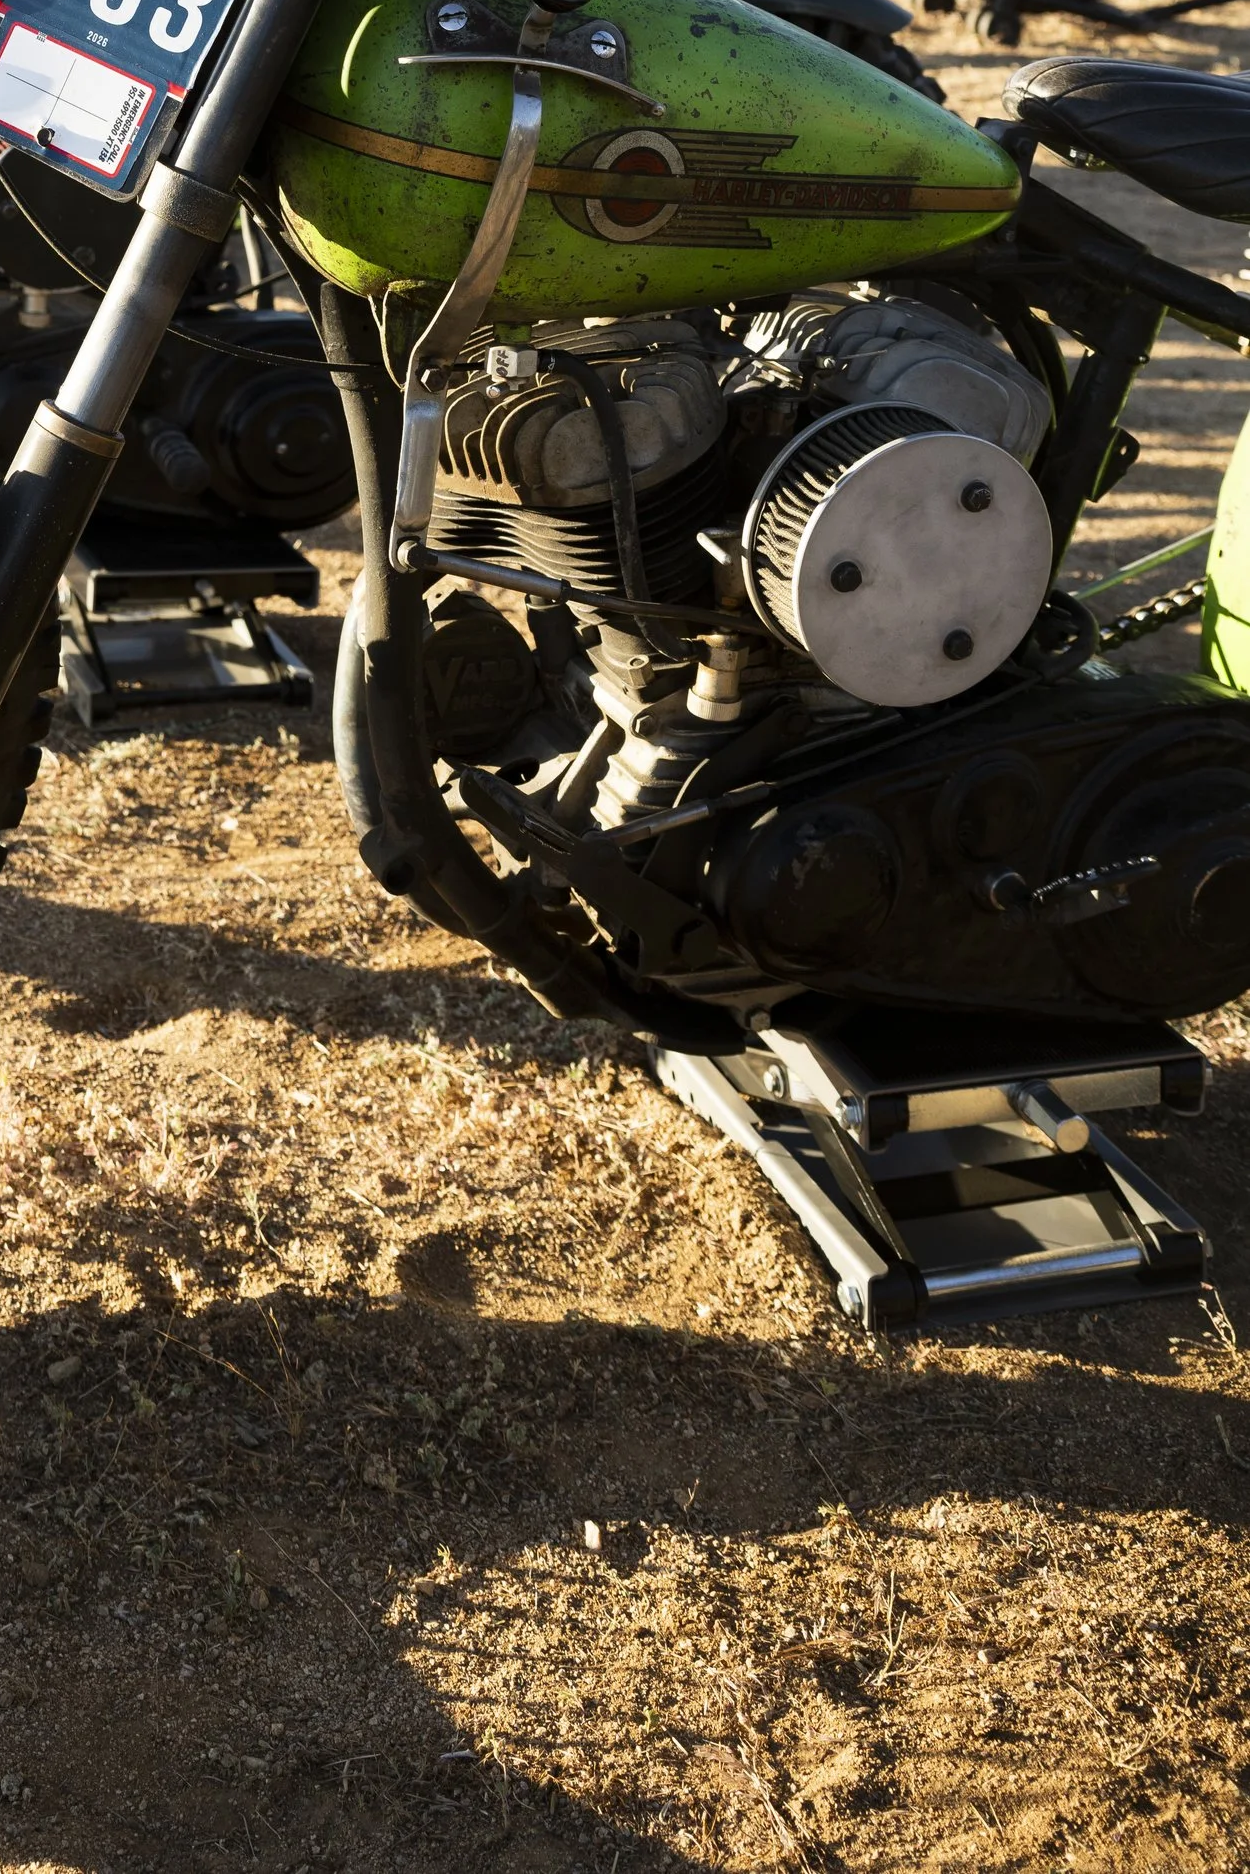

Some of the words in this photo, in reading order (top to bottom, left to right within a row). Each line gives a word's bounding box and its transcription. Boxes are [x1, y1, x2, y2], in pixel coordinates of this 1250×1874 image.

[86, 30, 109, 48] 2026
[137, 89, 146, 100] IN
[110, 85, 138, 136] 951-699-1500
[117, 98, 142, 145] EMERGENCY
[105, 135, 115, 148] XT
[98, 147, 110, 163] 138
[106, 143, 121, 165] CALL:
[693, 178, 910, 211] HARLEY-DAVIDSON
